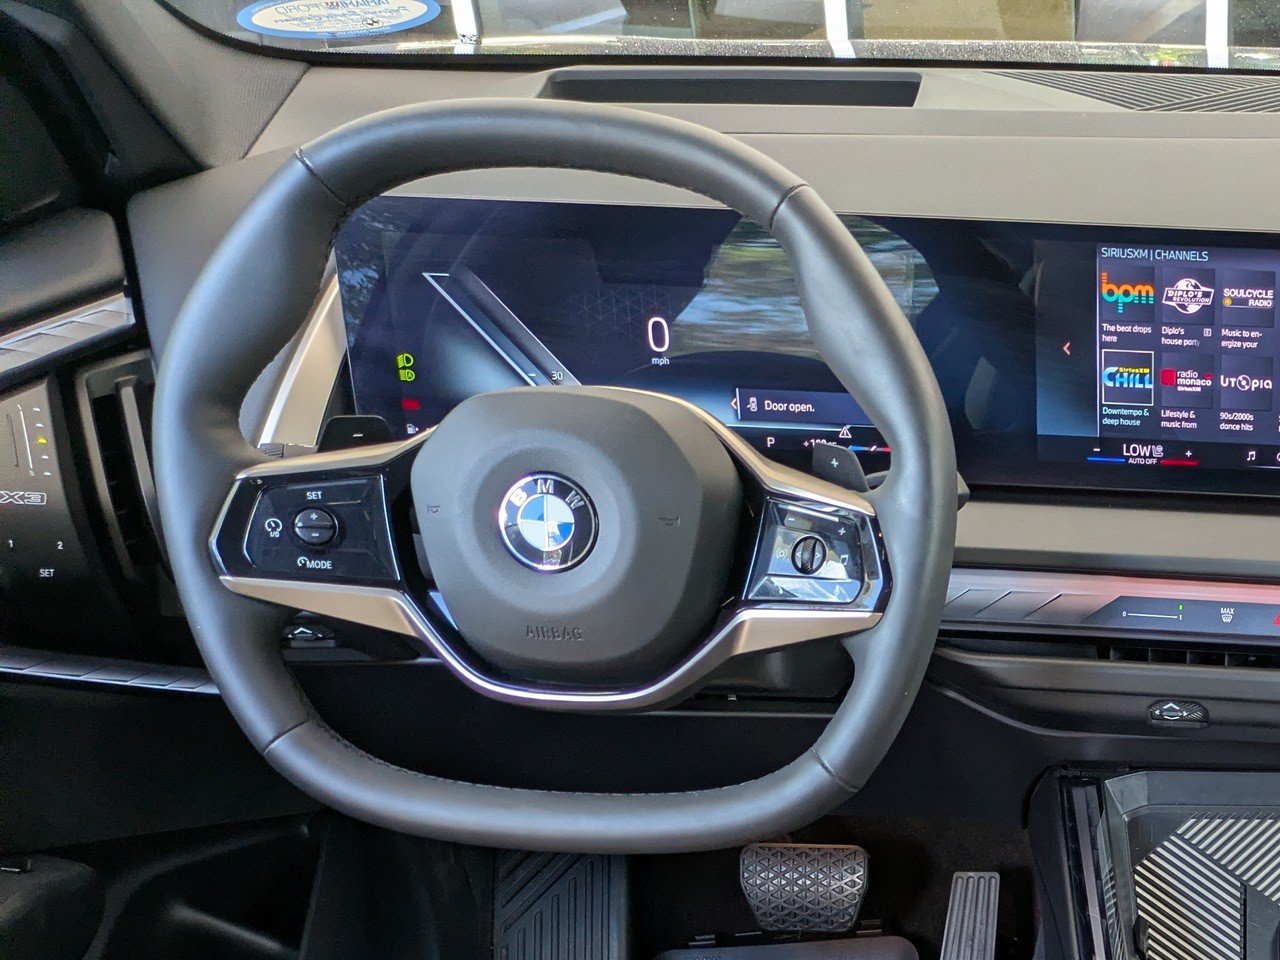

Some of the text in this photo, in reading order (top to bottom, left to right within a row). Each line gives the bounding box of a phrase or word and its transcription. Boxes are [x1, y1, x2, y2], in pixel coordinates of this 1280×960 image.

[1101, 247, 1209, 261] SIRIUSXM CHANNELS
[1101, 272, 1154, 313] bpm
[1167, 290, 1203, 298] DIPLO'S
[1223, 288, 1274, 299] SOULCYCLE
[1248, 299, 1272, 307] RADIO
[1102, 323, 1152, 335] The beat drops
[1161, 326, 1185, 336] Diplo's
[1221, 328, 1242, 338] Music
[648, 317, 669, 352] 0
[1102, 334, 1118, 343] here
[1161, 337, 1183, 346] house
[1221, 340, 1259, 350] ergize your
[651, 357, 670, 366] mph
[1118, 366, 1150, 374] SiriusXM
[1176, 369, 1199, 379] radio
[551, 370, 564, 381] 30
[1102, 366, 1154, 389] CHILL
[1176, 378, 1212, 387] monaco
[764, 400, 815, 413] Door open.
[1102, 406, 1143, 417] Downtempo
[1160, 409, 1188, 420] Lifestyle
[1219, 411, 1254, 421] 90s/2000s
[1102, 417, 1141, 427] deep house
[1160, 420, 1198, 429] music from
[1219, 422, 1254, 431] dance hits
[766, 436, 776, 448] P
[1123, 443, 1151, 457] LOW
[1128, 457, 1145, 465] AUTO
[306, 491, 322, 500] SET
[509, 478, 585, 510] BMW
[56, 541, 63, 550] 2
[306, 560, 333, 570] MODE
[39, 569, 54, 577] SET
[1220, 607, 1235, 615] MAX
[525, 625, 584, 641] AIRBAG
